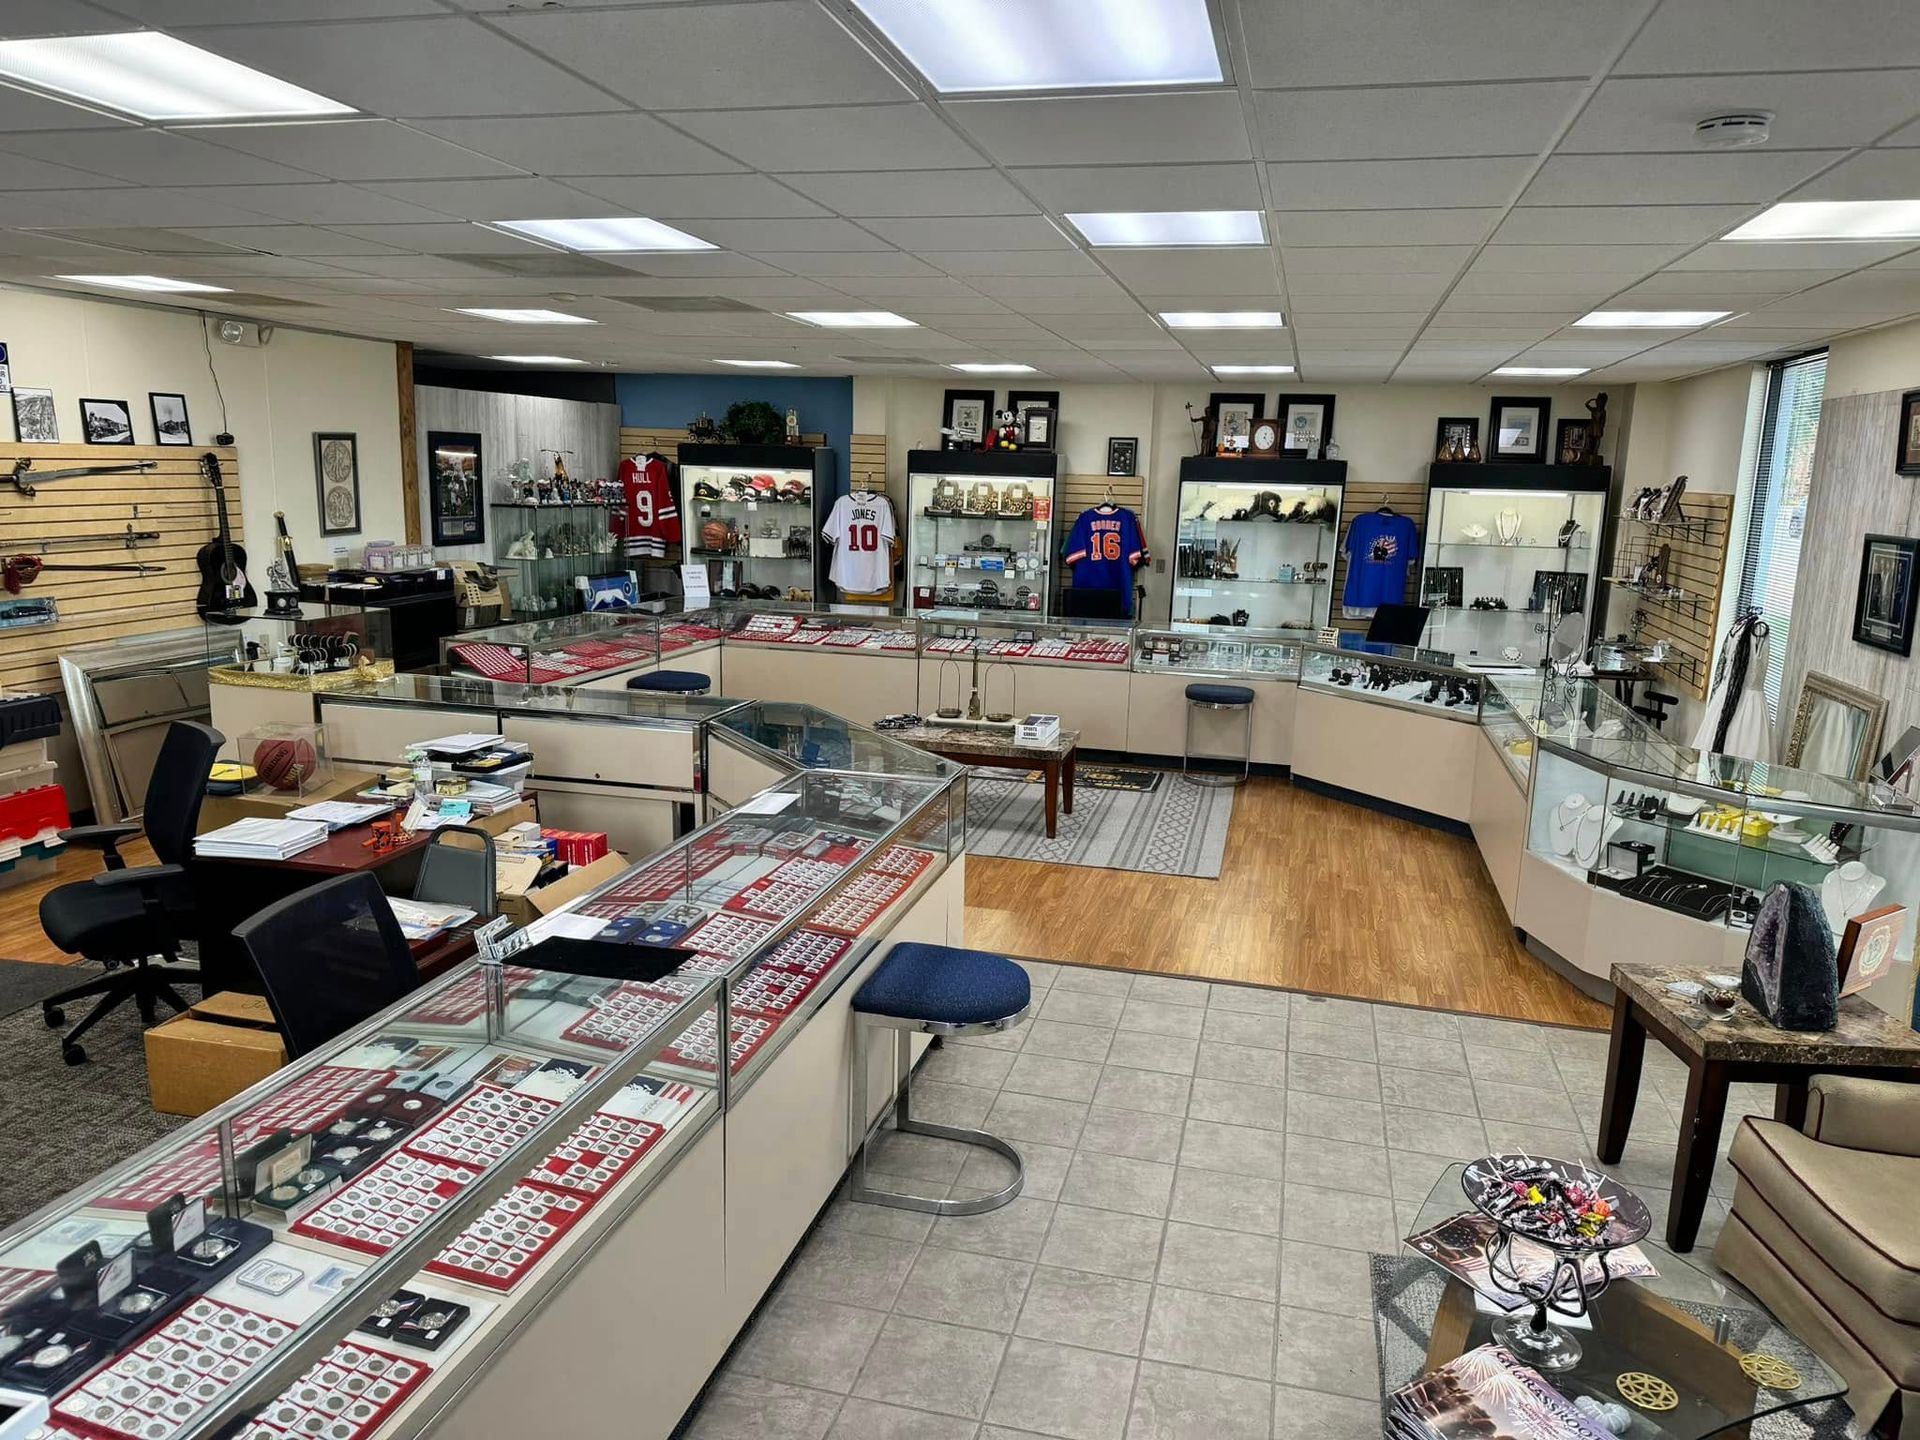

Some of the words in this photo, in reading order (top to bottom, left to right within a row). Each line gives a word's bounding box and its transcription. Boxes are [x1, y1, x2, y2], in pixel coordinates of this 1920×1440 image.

[632, 472, 652, 484] HULL
[636, 490, 654, 527] 9
[851, 508, 877, 521] JONES
[848, 523, 878, 552] 10
[1090, 532, 1121, 561] 16
